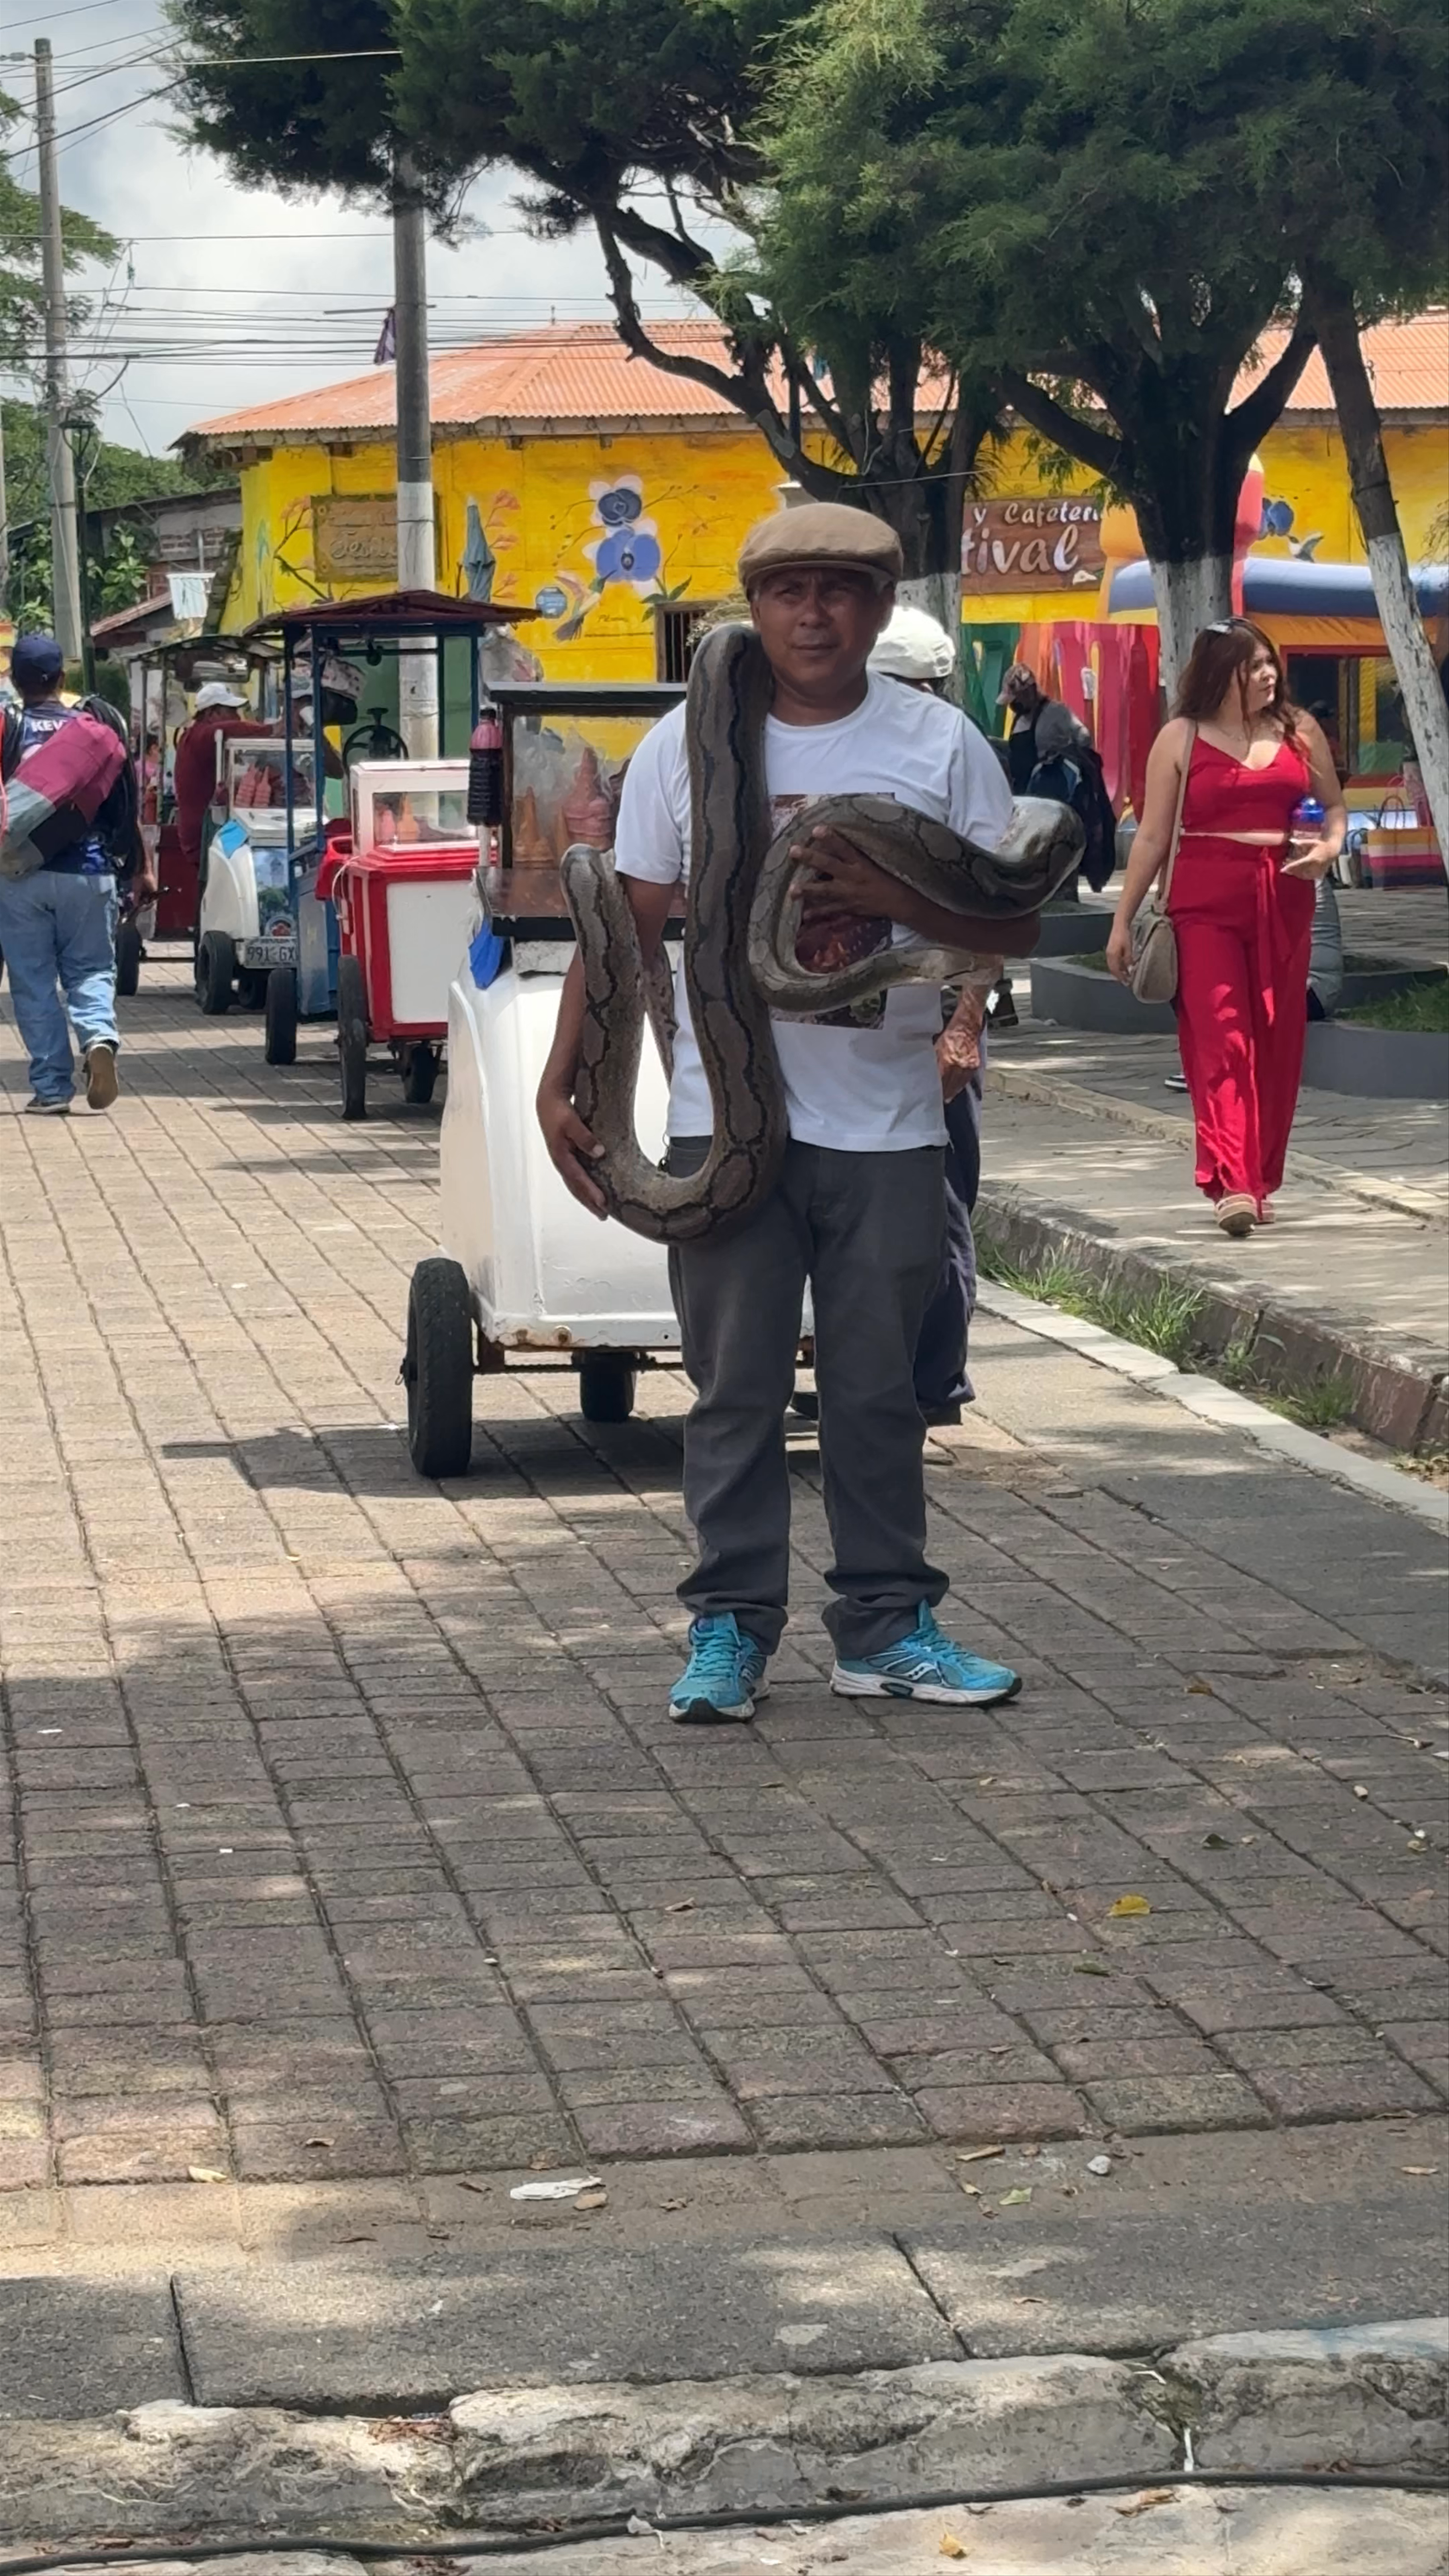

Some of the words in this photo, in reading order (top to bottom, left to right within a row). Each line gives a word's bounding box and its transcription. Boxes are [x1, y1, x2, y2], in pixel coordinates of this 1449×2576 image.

[974, 508, 986, 527] y
[1004, 501, 1099, 527] Cafeteri
[961, 524, 1078, 575] tival
[31, 719, 68, 732] KEV
[280, 946, 298, 961] GX
